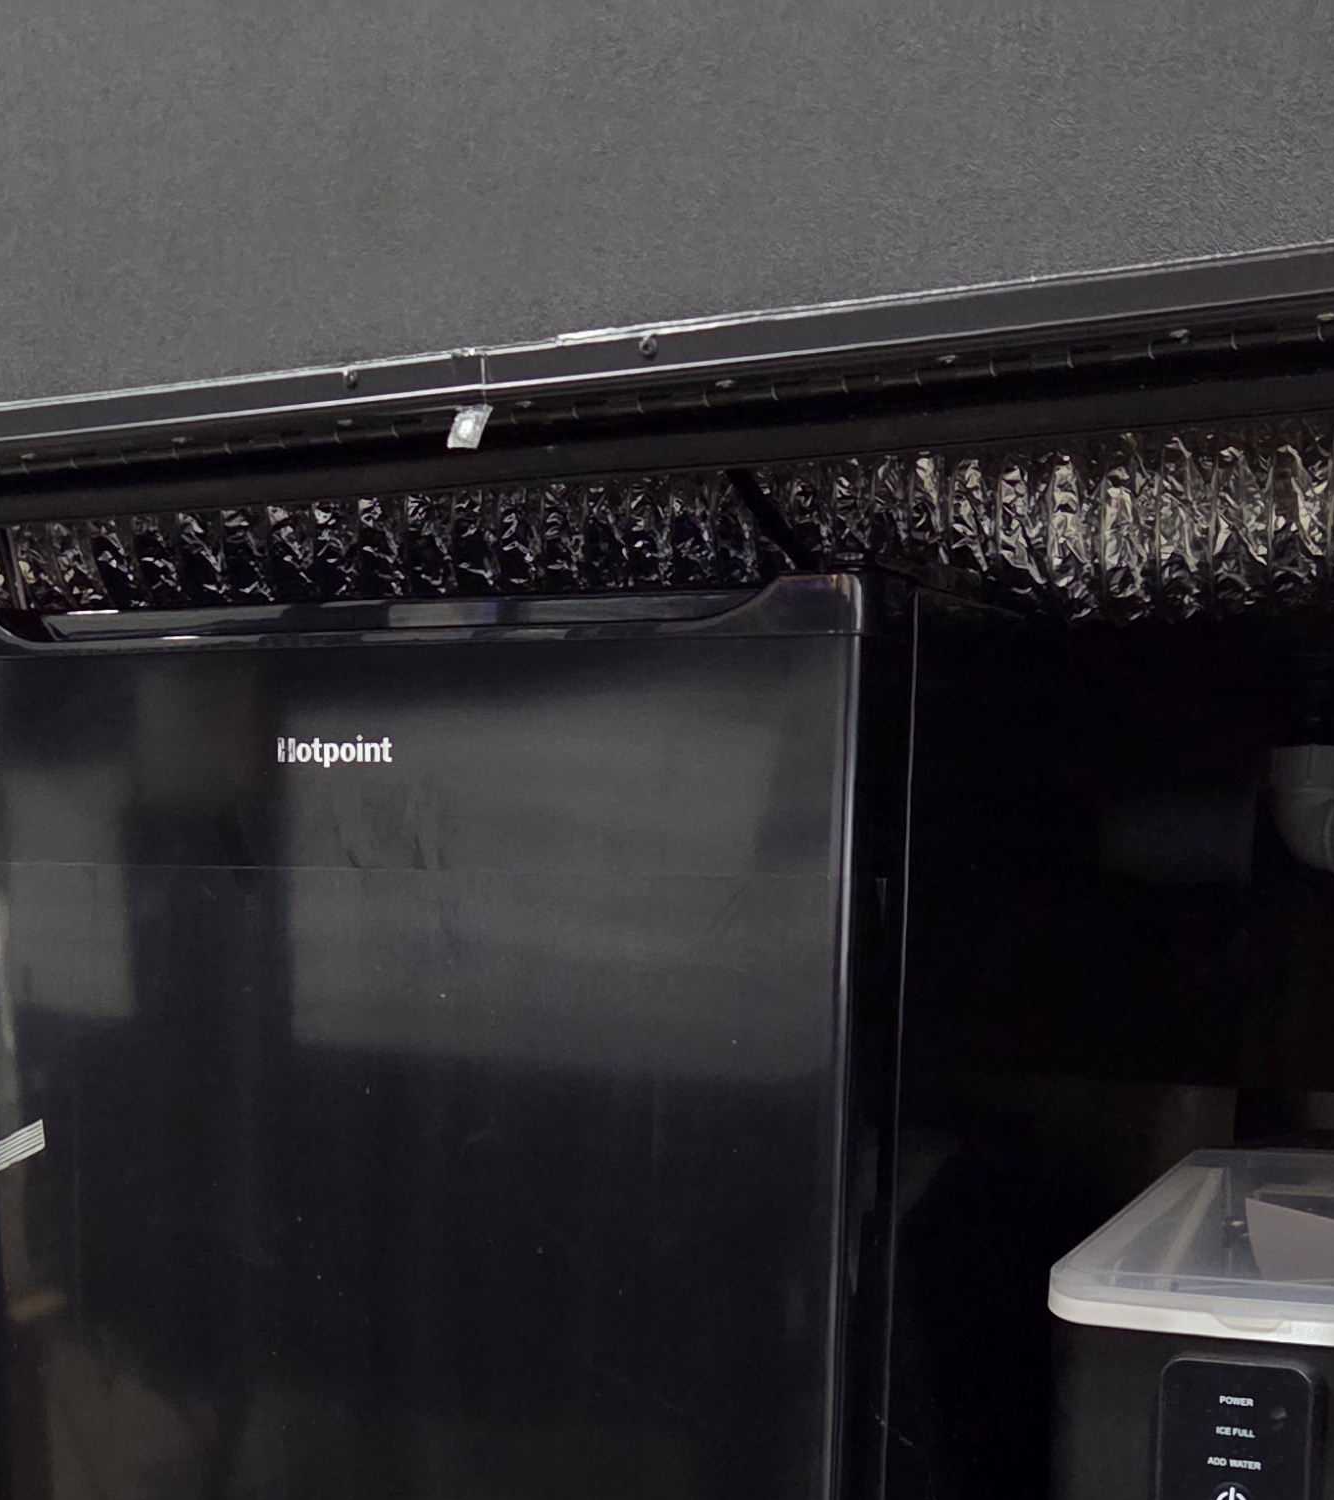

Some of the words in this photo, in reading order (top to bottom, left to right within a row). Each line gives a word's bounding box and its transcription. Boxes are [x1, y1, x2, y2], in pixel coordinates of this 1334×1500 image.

[277, 734, 392, 767] Hotpoint
[1219, 1396, 1253, 1407] POWER
[1216, 1426, 1231, 1436] ICE
[1233, 1428, 1255, 1438] FULL
[1207, 1457, 1227, 1467] ADD
[1229, 1459, 1261, 1470] WATER
